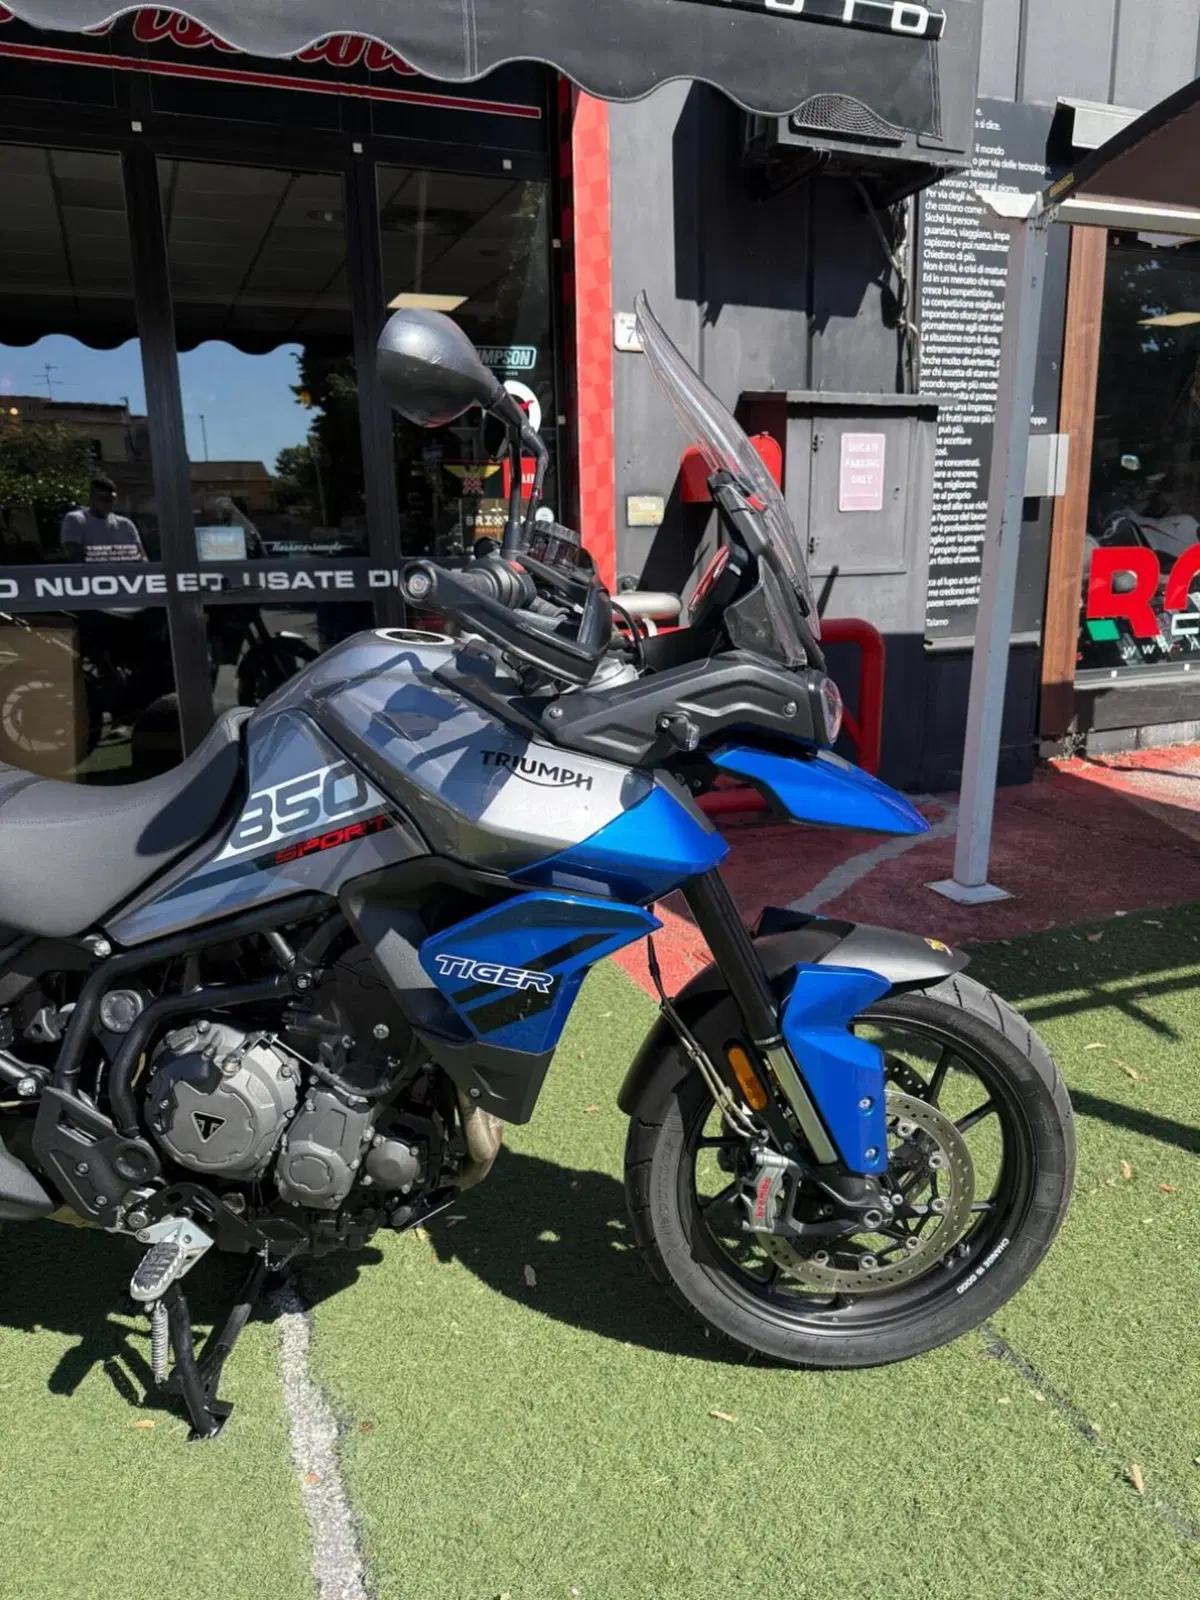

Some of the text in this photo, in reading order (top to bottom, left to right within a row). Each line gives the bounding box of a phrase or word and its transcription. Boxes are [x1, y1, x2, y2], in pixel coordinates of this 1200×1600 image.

[980, 145, 1005, 156] mondo
[979, 158, 989, 168] per
[990, 158, 1000, 168] via
[1001, 160, 1017, 170] delle
[925, 188, 936, 198] Per
[938, 189, 947, 199] via
[948, 191, 965, 202] degli
[925, 200, 982, 214] che costano come
[946, 214, 952, 224] le
[953, 216, 979, 226] persone
[924, 226, 958, 238] guardano,
[959, 228, 992, 240] viaggiano,
[924, 238, 956, 248] capiscono
[962, 241, 973, 251] poi
[923, 249, 956, 260] Chiedono
[956, 251, 963, 260] di
[923, 261, 938, 271] Non
[938, 262, 943, 272] è
[944, 263, 958, 274] crisi,
[958, 263, 963, 273] è
[964, 264, 977, 274] crisi
[977, 264, 984, 274] di
[922, 272, 932, 282] Ed
[933, 273, 940, 283] in
[940, 276, 950, 284] un
[950, 276, 977, 286] mercato
[978, 277, 989, 287] che
[922, 286, 942, 295] cresce
[943, 285, 949, 296] la
[921, 296, 1002, 311] La competizione migliora
[960, 311, 977, 320] sforzi
[978, 312, 990, 322] per
[921, 321, 965, 332] giornalmente
[966, 322, 977, 333] agli
[920, 332, 929, 341] La
[930, 332, 962, 342] situazione
[963, 336, 976, 344] non
[926, 344, 972, 354] estremamente
[972, 346, 984, 356] più
[942, 356, 960, 366] molto
[932, 367, 942, 377] chi
[943, 368, 965, 377] accetta
[966, 368, 972, 378] di
[973, 369, 988, 378] stare
[947, 380, 967, 391] regole
[968, 380, 979, 391] più
[946, 413, 962, 423] frutti
[963, 415, 980, 423] senza
[981, 414, 991, 425] più
[938, 424, 951, 435] può
[943, 437, 972, 446] accettare
[940, 491, 947, 500] al
[947, 491, 972, 501] proprio
[942, 502, 951, 510] ed
[951, 501, 963, 511] alle
[963, 502, 975, 510] sue
[960, 511, 969, 521] del
[945, 535, 956, 545] per
[957, 533, 964, 543] la
[934, 545, 957, 557] proprio
[937, 556, 953, 565] fatto
[34, 575, 168, 597] NUOVE
[243, 570, 355, 590] USATE
[937, 578, 944, 586] al
[944, 577, 959, 587] lupo
[963, 576, 978, 585] tutti
[939, 587, 965, 597] credono
[965, 586, 976, 595] nel
[480, 750, 593, 791] TRIUMPH
[230, 763, 370, 850] 850
[275, 815, 388, 864] SPORT
[435, 954, 554, 994] TIGER
